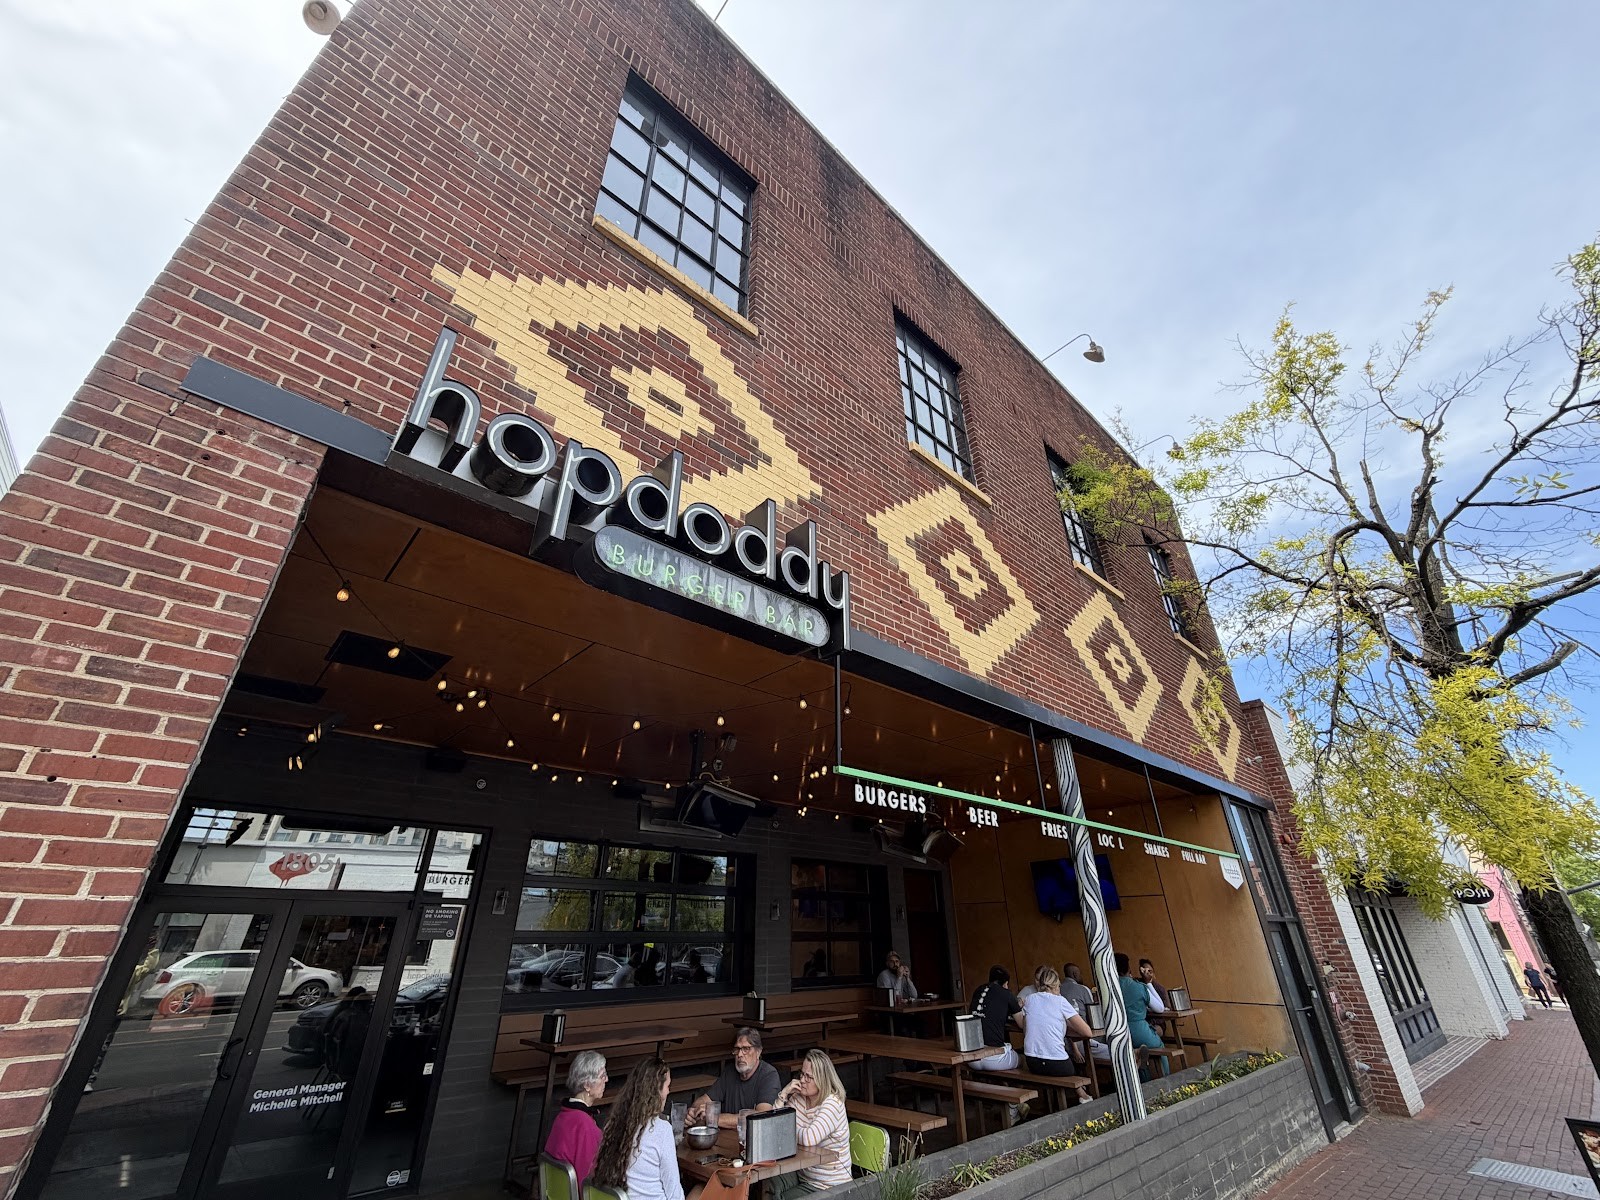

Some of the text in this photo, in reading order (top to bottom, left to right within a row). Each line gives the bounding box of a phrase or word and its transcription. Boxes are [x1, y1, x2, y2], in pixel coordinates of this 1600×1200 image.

[405, 326, 852, 650] hopdoddy
[611, 544, 813, 638] BURGER BAR
[854, 783, 926, 814] BURGERS
[968, 806, 999, 828] BEER
[1040, 821, 1068, 840] FRIES
[1143, 842, 1170, 858] SHAKES
[1181, 850, 1207, 865] FULL BAR
[281, 851, 336, 872] 1805
[253, 1081, 347, 1099] General Manager
[249, 1092, 343, 1113] Michelle Mitchell
